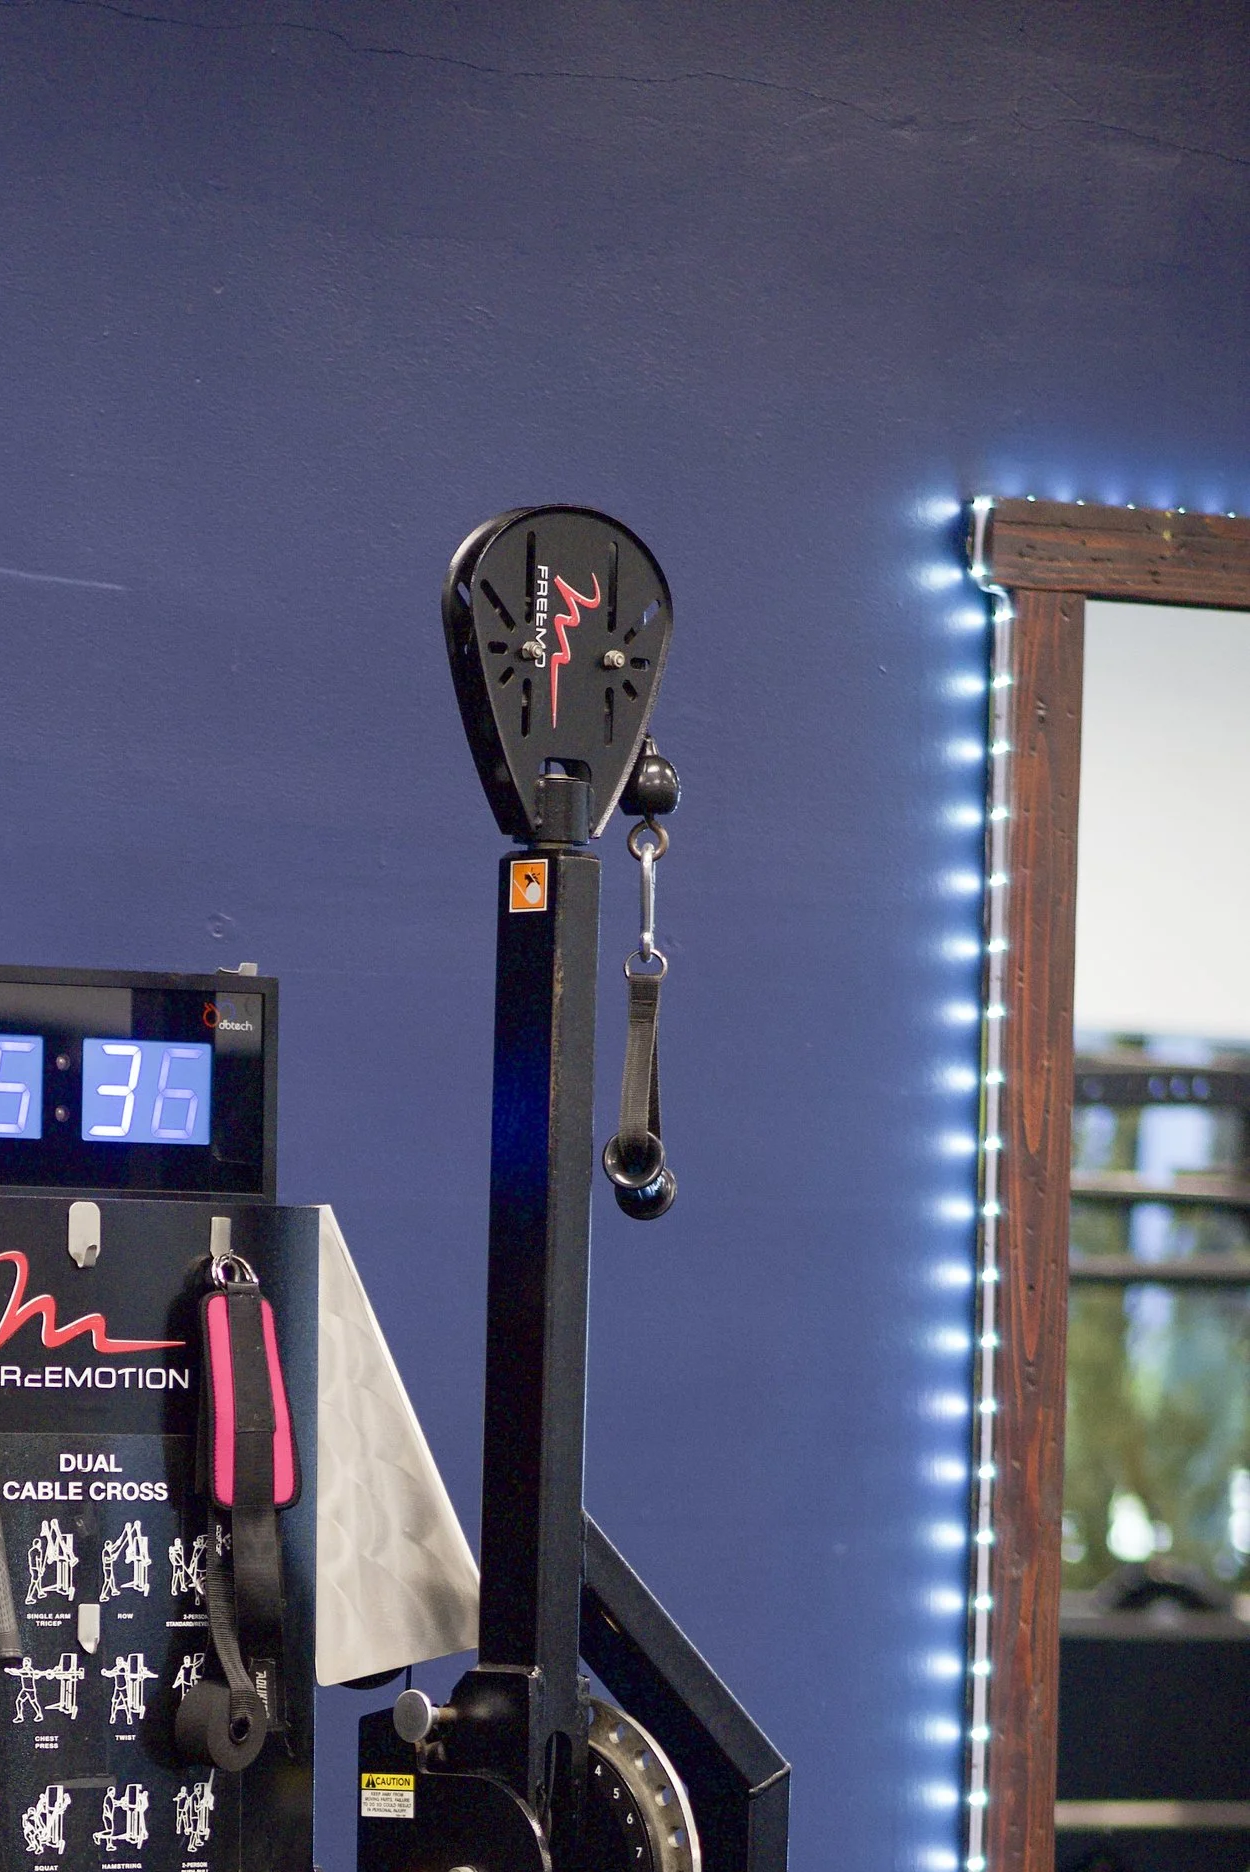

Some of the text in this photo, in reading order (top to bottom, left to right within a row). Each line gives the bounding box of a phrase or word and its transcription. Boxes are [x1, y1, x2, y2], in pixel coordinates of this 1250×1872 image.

[219, 1019, 253, 1031] dbtech
[87, 1043, 204, 1140] 36
[60, 1453, 122, 1473] DUAL
[2, 1481, 168, 1501] CABLE CROSS
[595, 1765, 601, 1776] 4
[375, 1777, 410, 1786] CAUTION
[613, 1788, 619, 1799] 5
[626, 1813, 633, 1824] 6
[636, 1847, 642, 1858] 7
